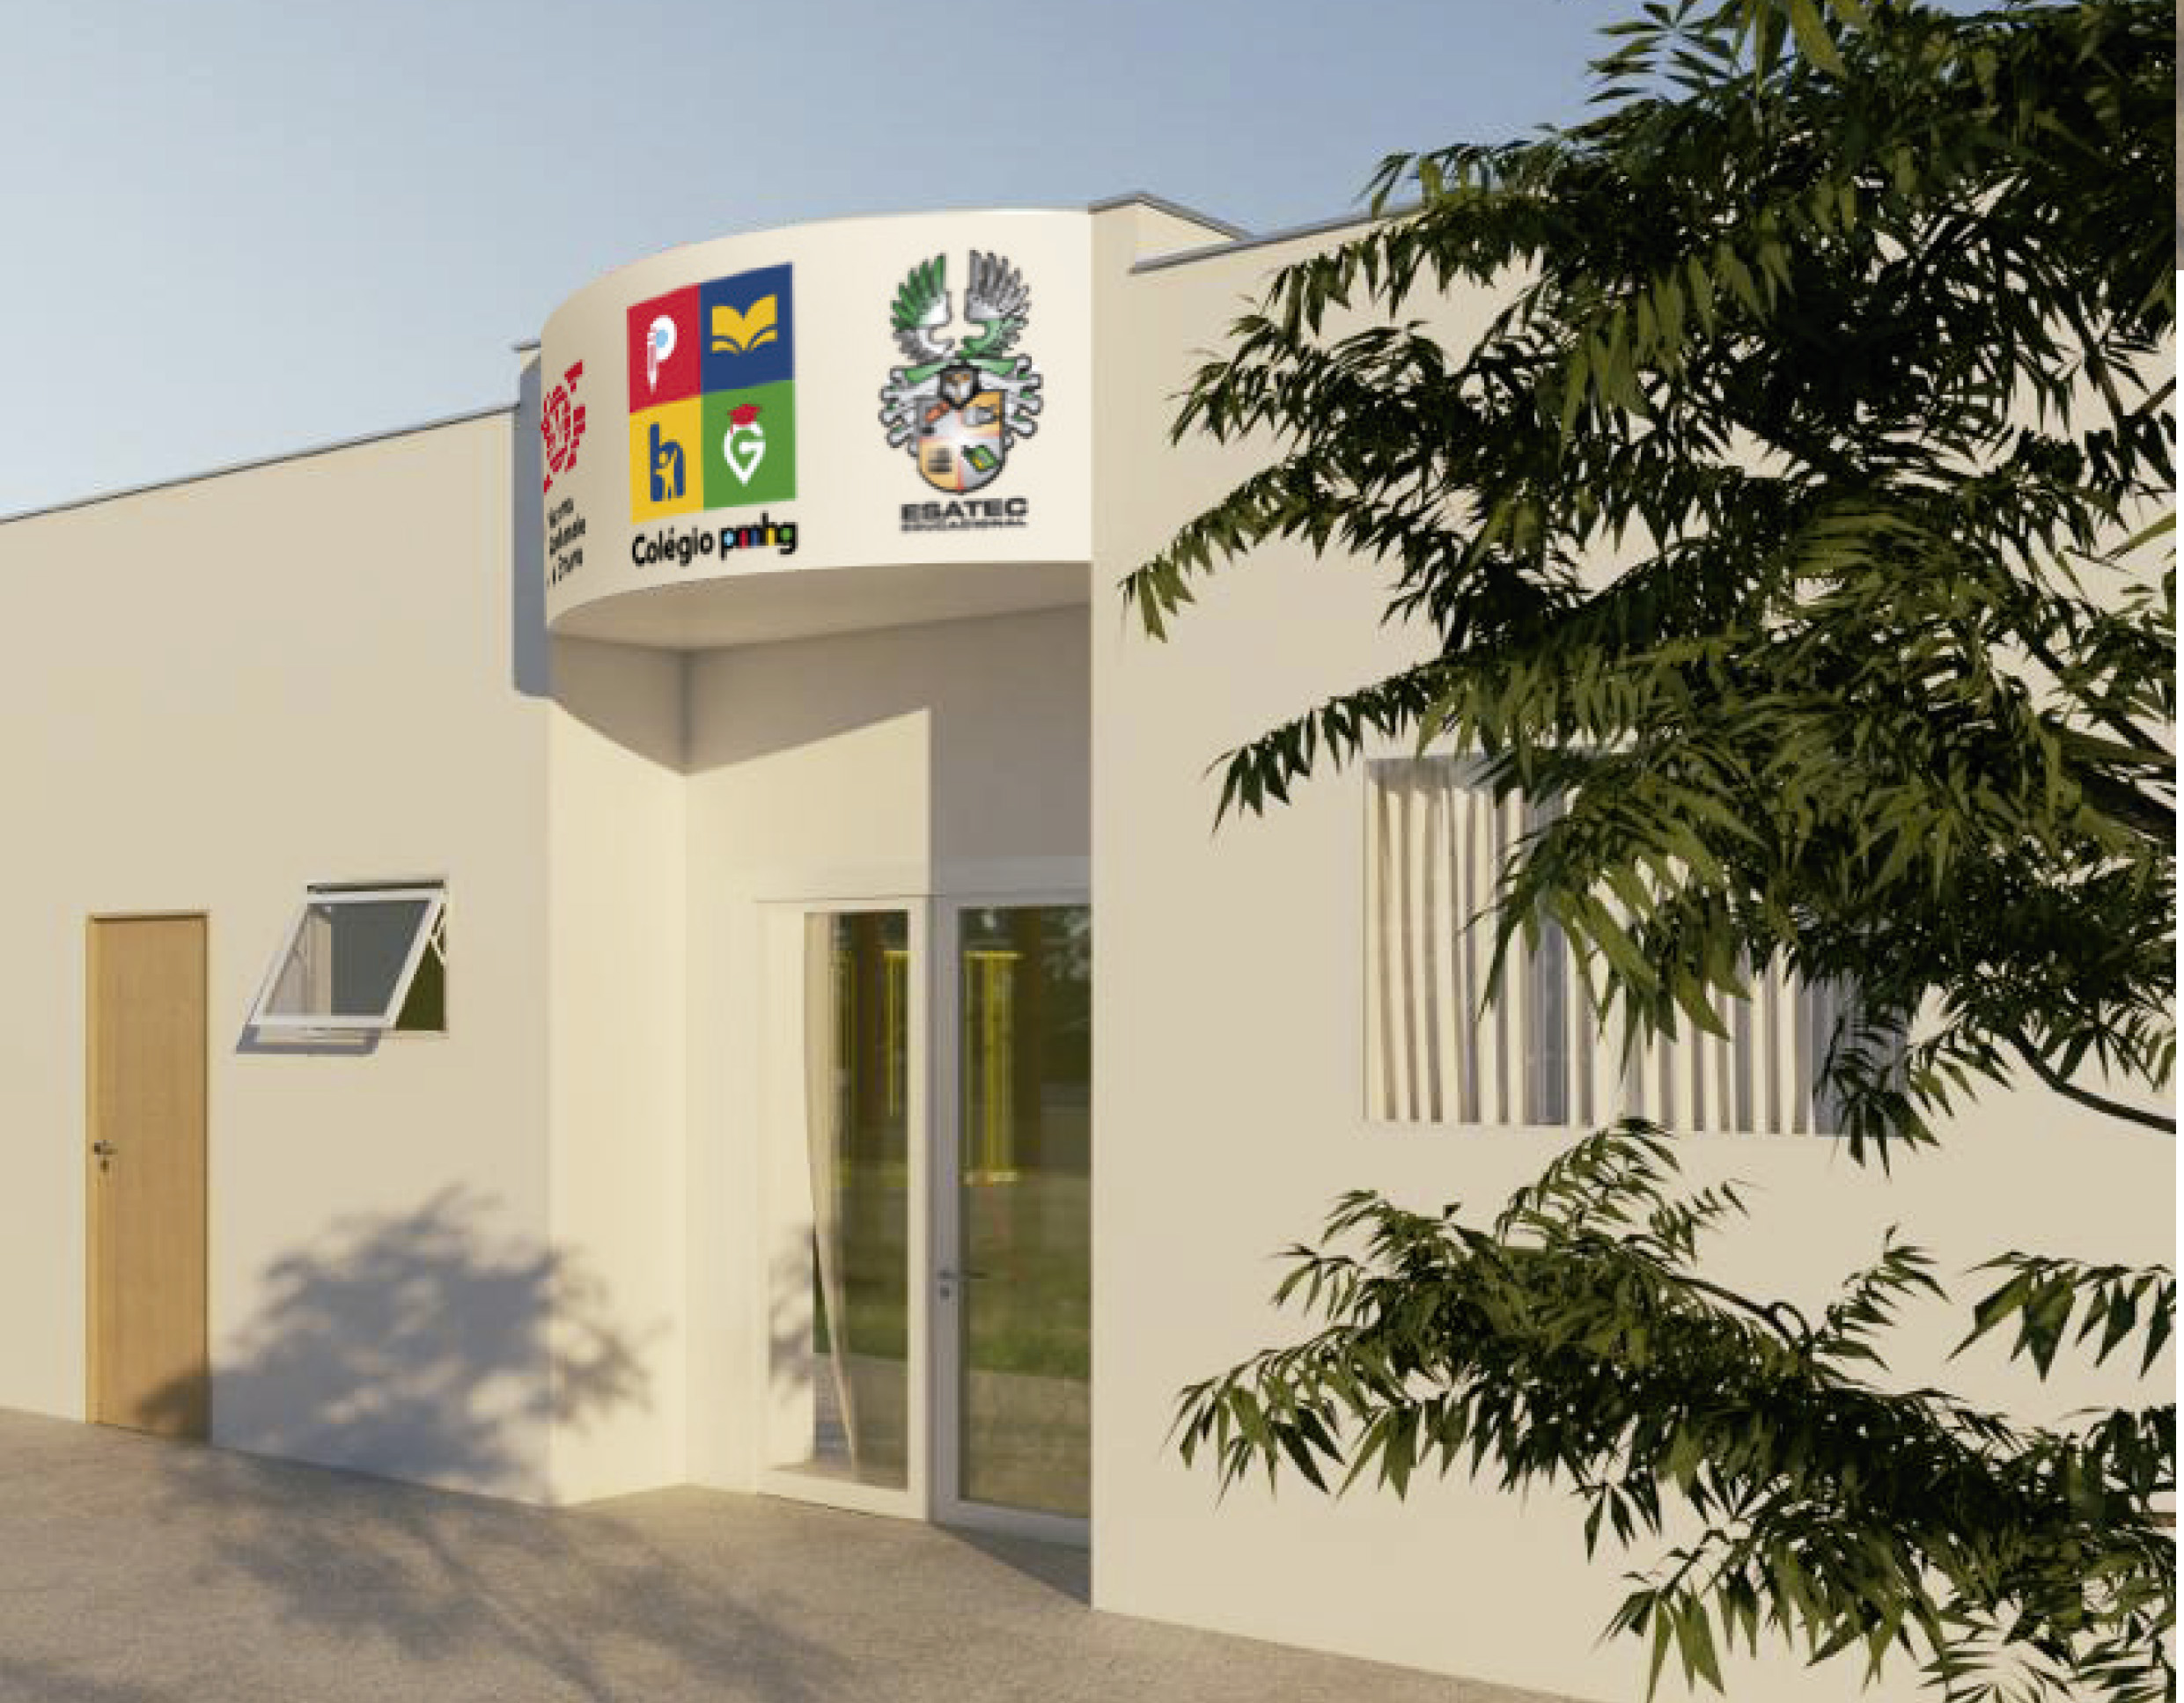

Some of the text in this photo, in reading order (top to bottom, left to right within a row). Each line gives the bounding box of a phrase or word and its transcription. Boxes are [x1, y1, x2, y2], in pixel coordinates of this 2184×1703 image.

[723, 423, 766, 486] G
[900, 496, 1029, 522] ESATEC
[631, 525, 715, 567] Colégio
